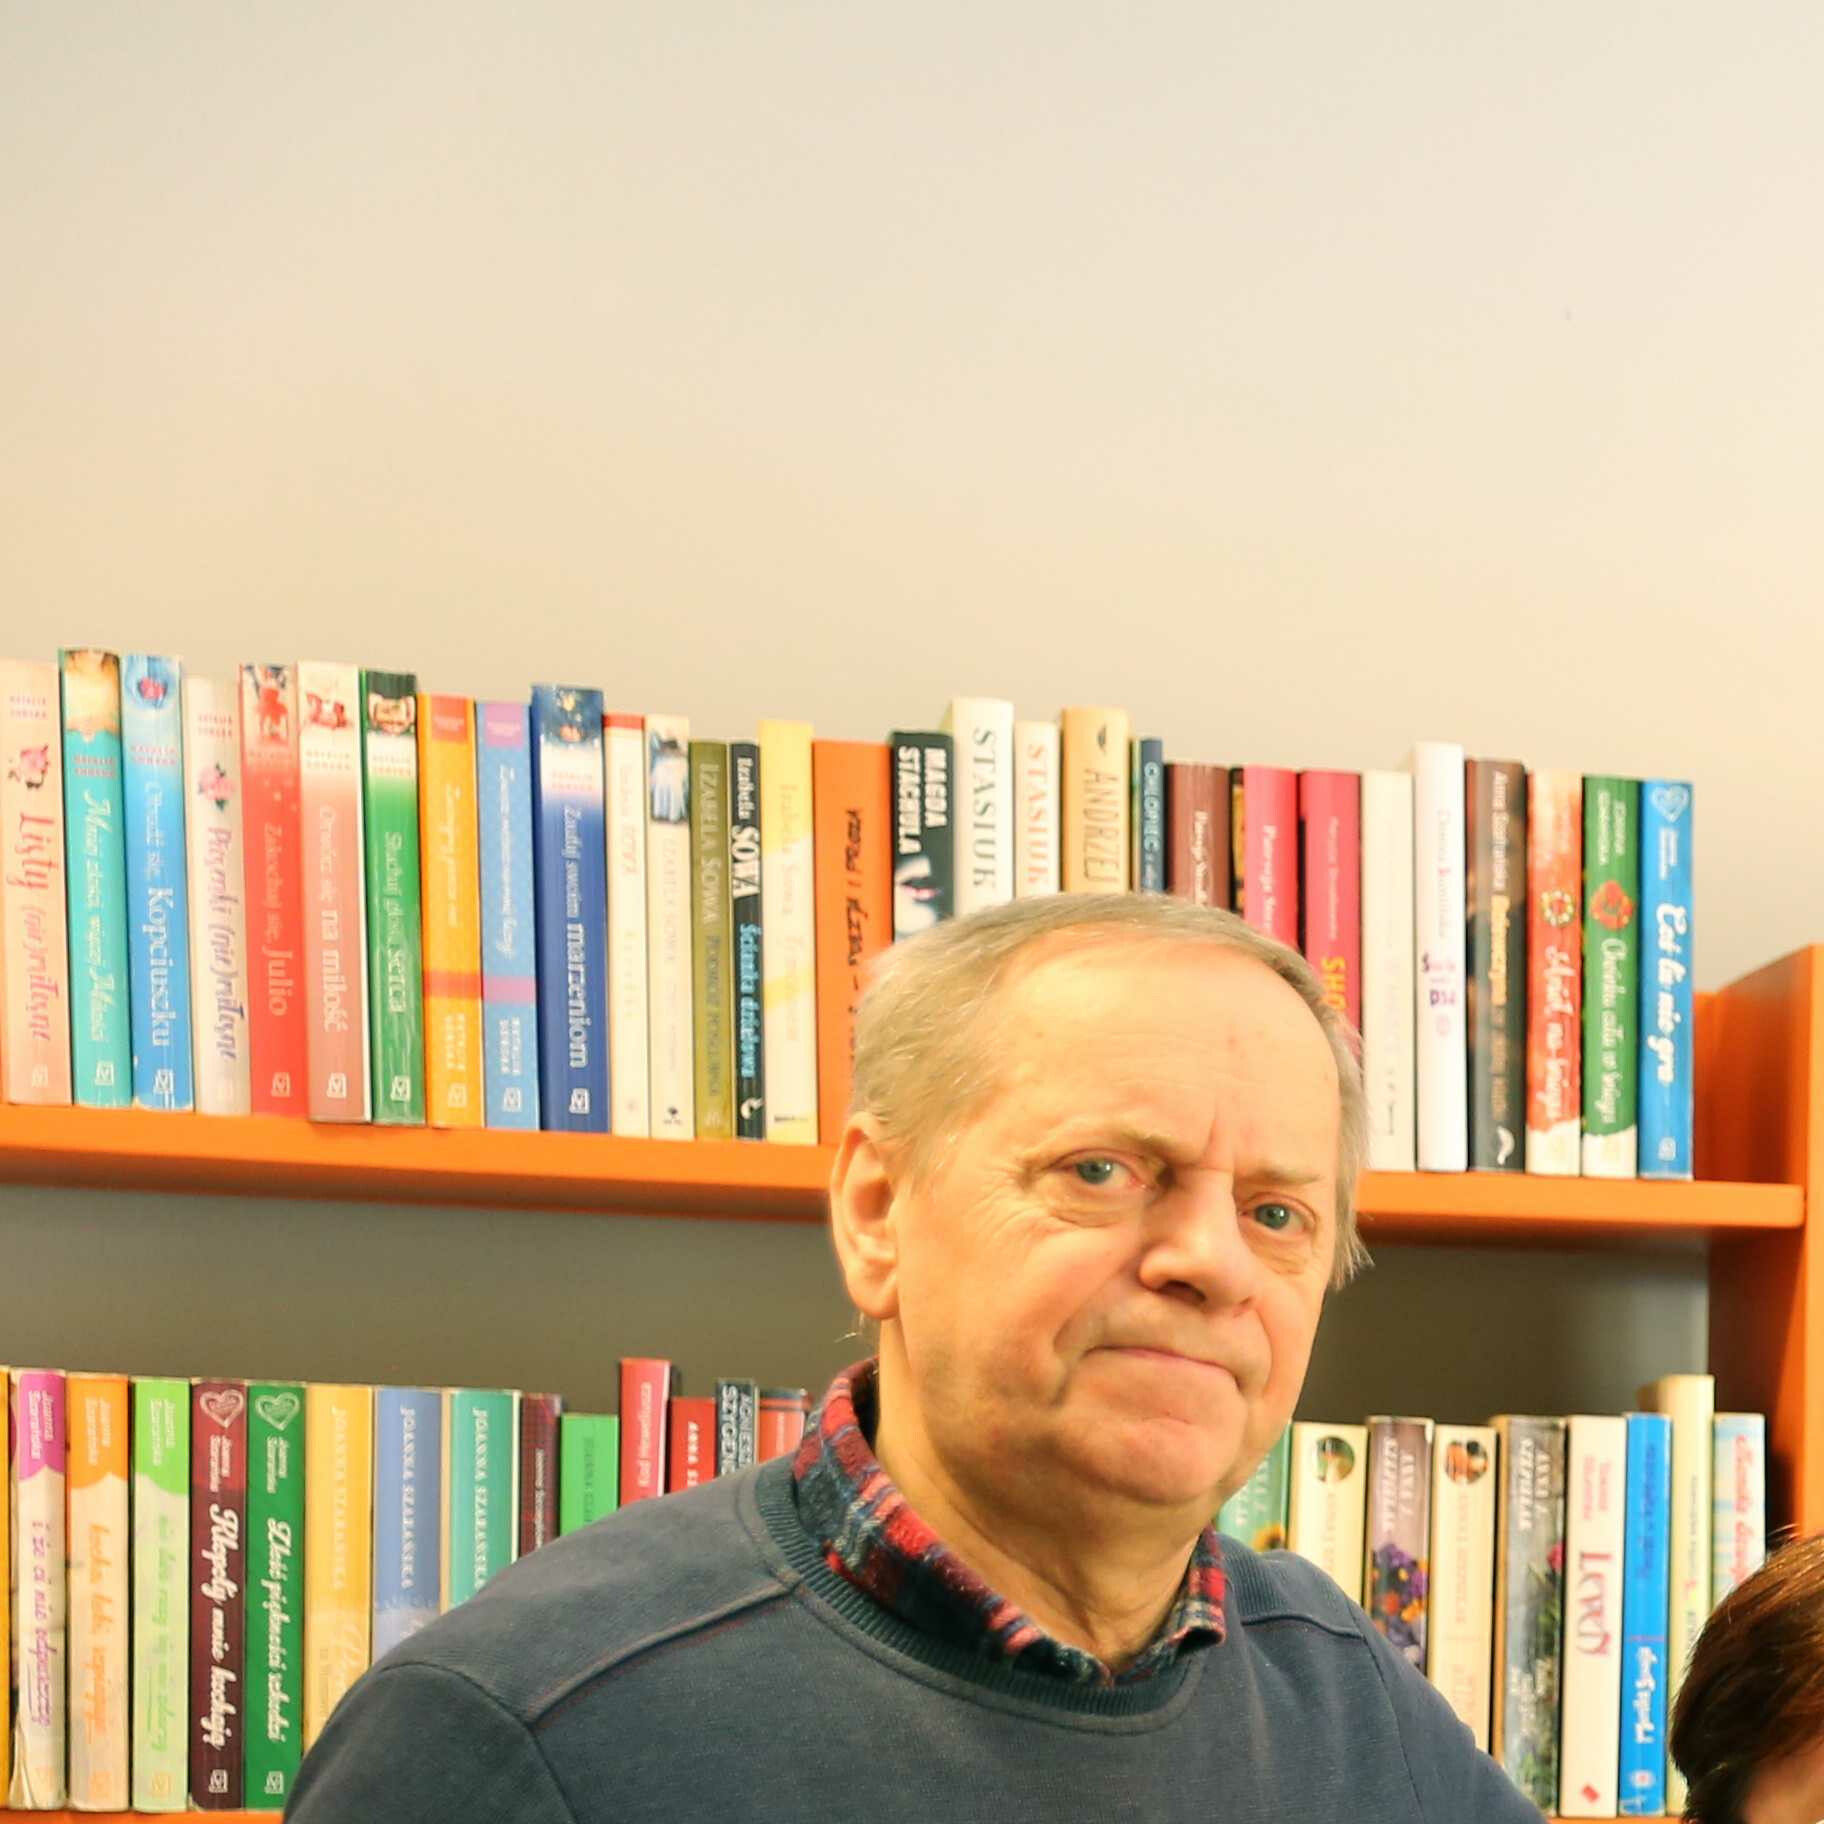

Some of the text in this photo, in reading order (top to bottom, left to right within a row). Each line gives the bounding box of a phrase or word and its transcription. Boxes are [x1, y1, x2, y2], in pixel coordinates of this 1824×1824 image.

[698, 762, 721, 852] IZABELA
[924, 747, 947, 829] MAGDA
[971, 726, 999, 890] STASIUK
[1026, 743, 1050, 885] STASIUK
[1081, 767, 1121, 885] ANDRZEJ
[7, 812, 58, 891] Listy
[730, 824, 761, 900] SOWA
[320, 909, 340, 941] na
[699, 856, 721, 926] SOWA
[143, 887, 176, 1046] Kopciuszku
[261, 945, 294, 1017] Julio
[320, 949, 349, 1033] miłość
[566, 923, 592, 1069] marzeniom
[1320, 955, 1347, 1011] SHO
[1656, 992, 1677, 1034] nie
[1646, 1034, 1677, 1084] gra
[399, 1407, 417, 1481] JOANNA
[471, 1407, 489, 1481] JOANNA
[687, 1421, 699, 1465] ANNA
[34, 1590, 53, 1622] nie
[197, 1503, 241, 1751] Kłopoty mnie kochają
